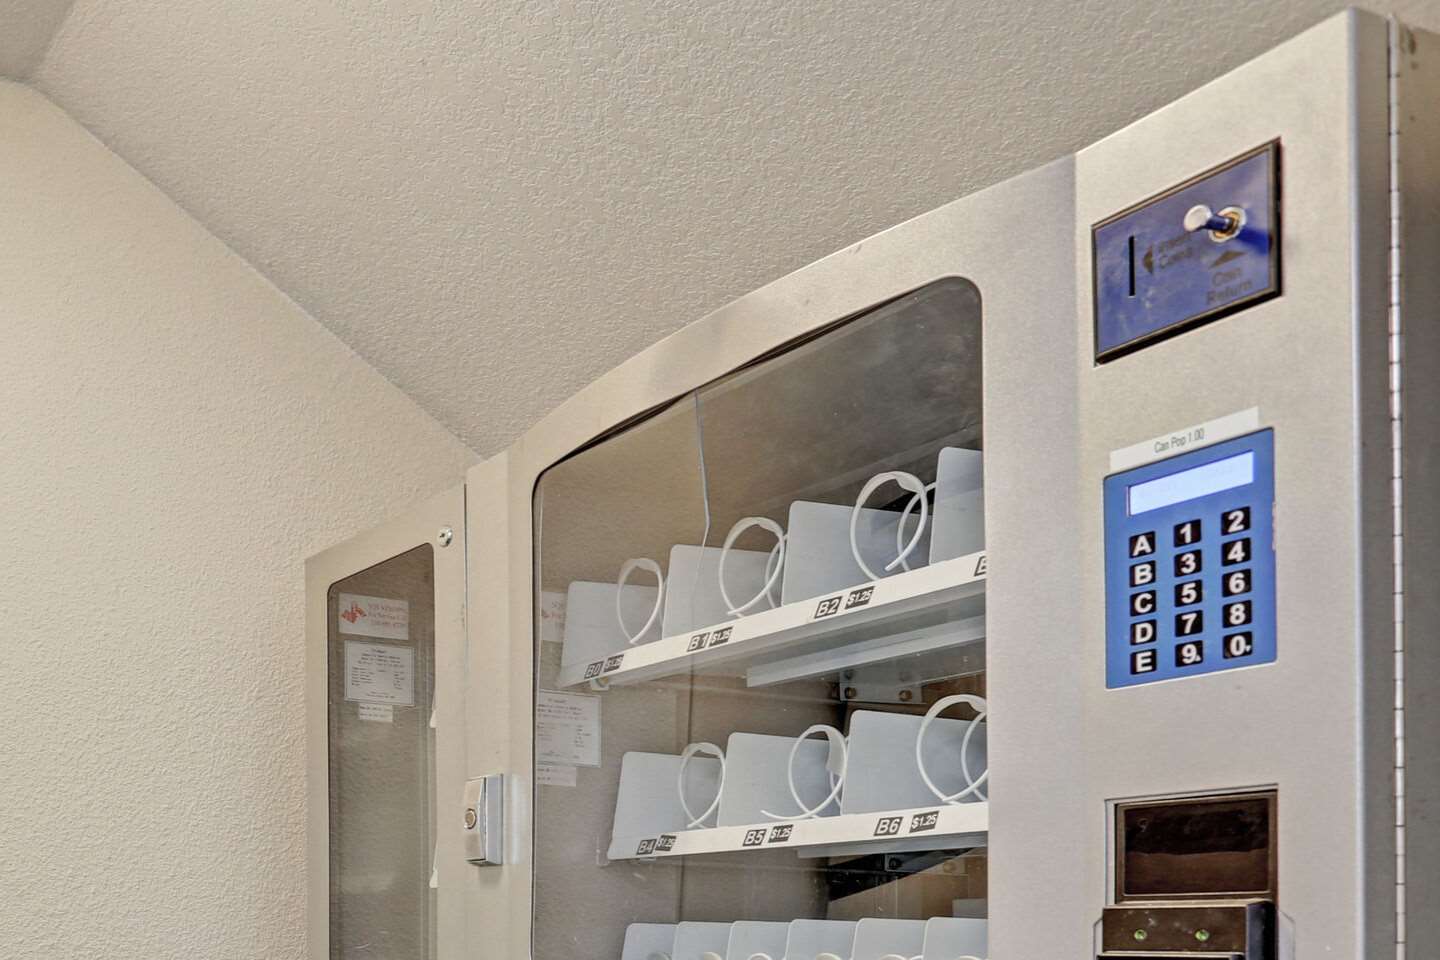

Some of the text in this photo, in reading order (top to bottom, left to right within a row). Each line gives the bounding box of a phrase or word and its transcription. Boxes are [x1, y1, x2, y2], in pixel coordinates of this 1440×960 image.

[1132, 510, 1245, 556] A 1 2
[1134, 541, 1245, 585] B 3 4
[1134, 572, 1245, 613] C 5 6
[817, 600, 840, 616] B2
[1135, 603, 1246, 644] D 7 8
[689, 634, 707, 650] B1
[1135, 651, 1153, 673] E
[876, 814, 937, 834] B6 $1.25
[638, 841, 654, 854] B4
[744, 831, 764, 845] B5
